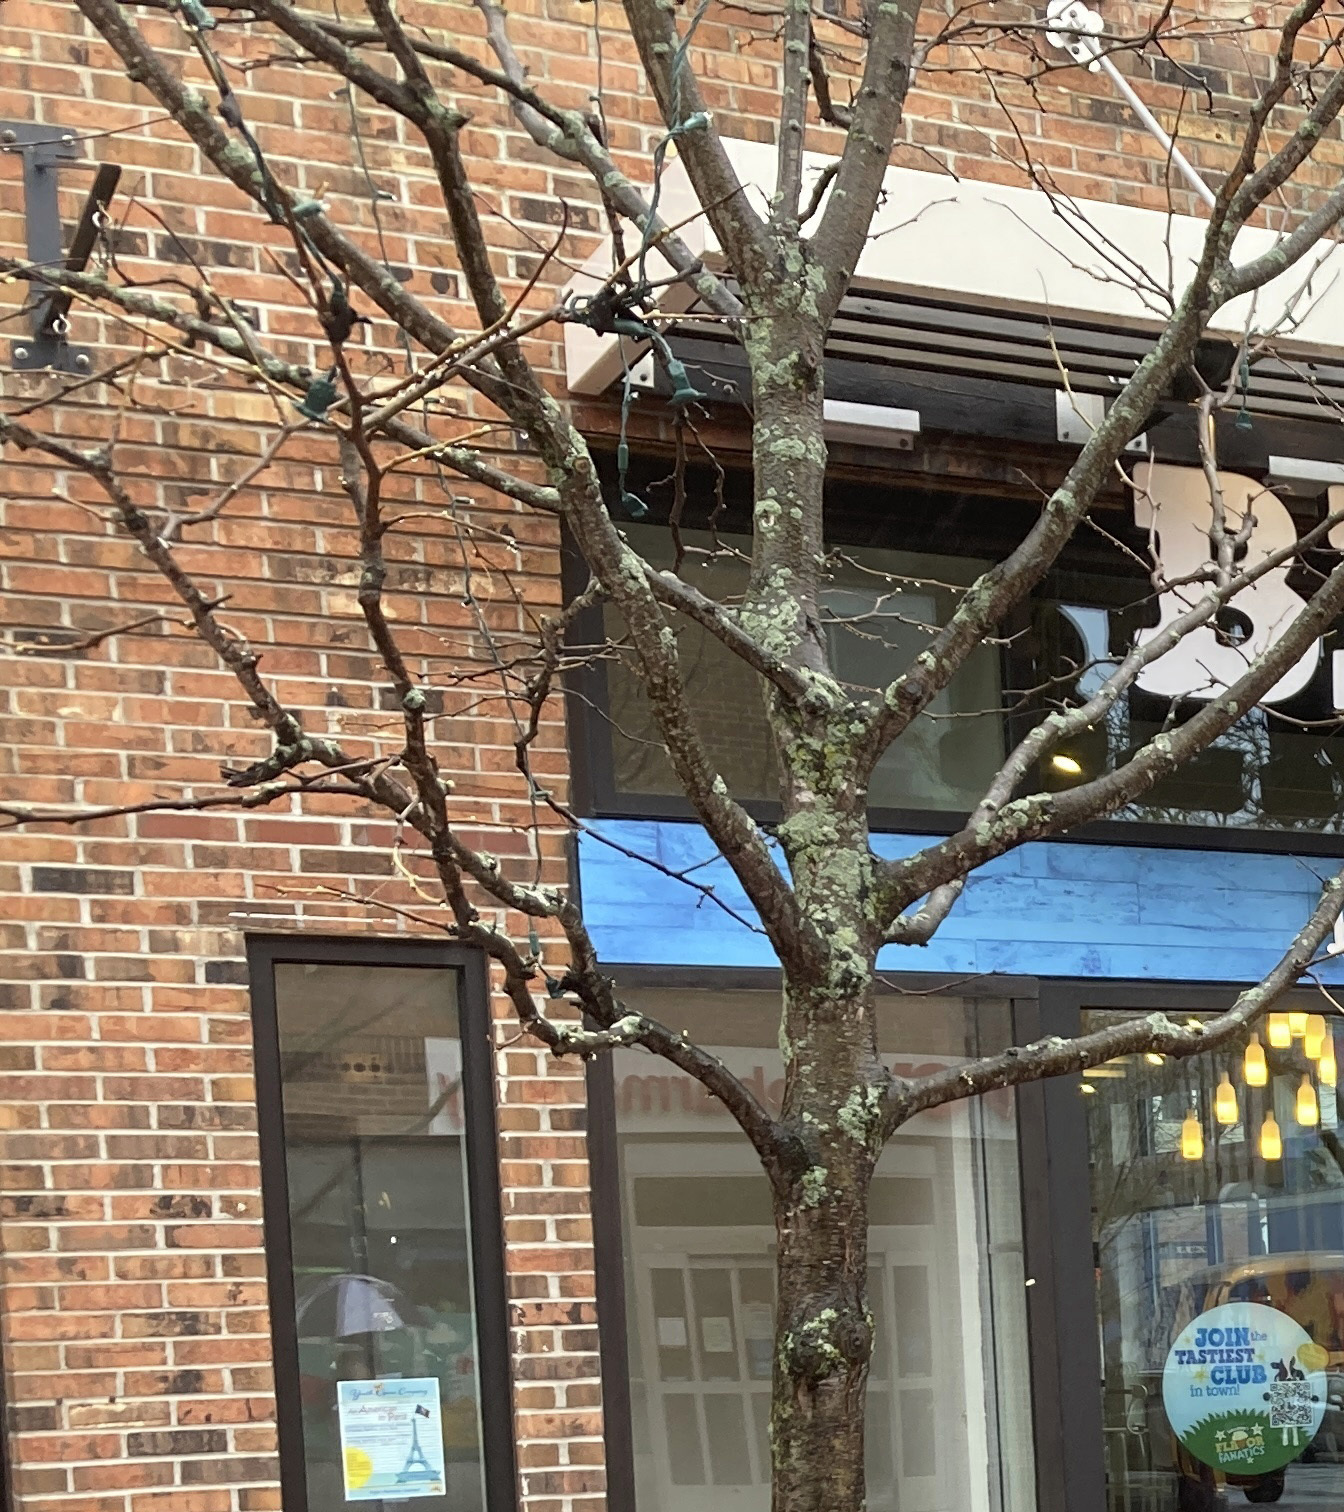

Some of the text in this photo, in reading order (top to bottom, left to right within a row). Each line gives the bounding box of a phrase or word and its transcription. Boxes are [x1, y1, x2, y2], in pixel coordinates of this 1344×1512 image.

[1195, 1328, 1267, 1347] JOIN the
[1175, 1348, 1255, 1364] TASTIEST
[1210, 1365, 1267, 1385] CLUB
[1190, 1384, 1240, 1398] in town!
[1218, 1447, 1265, 1464] FANATICS
